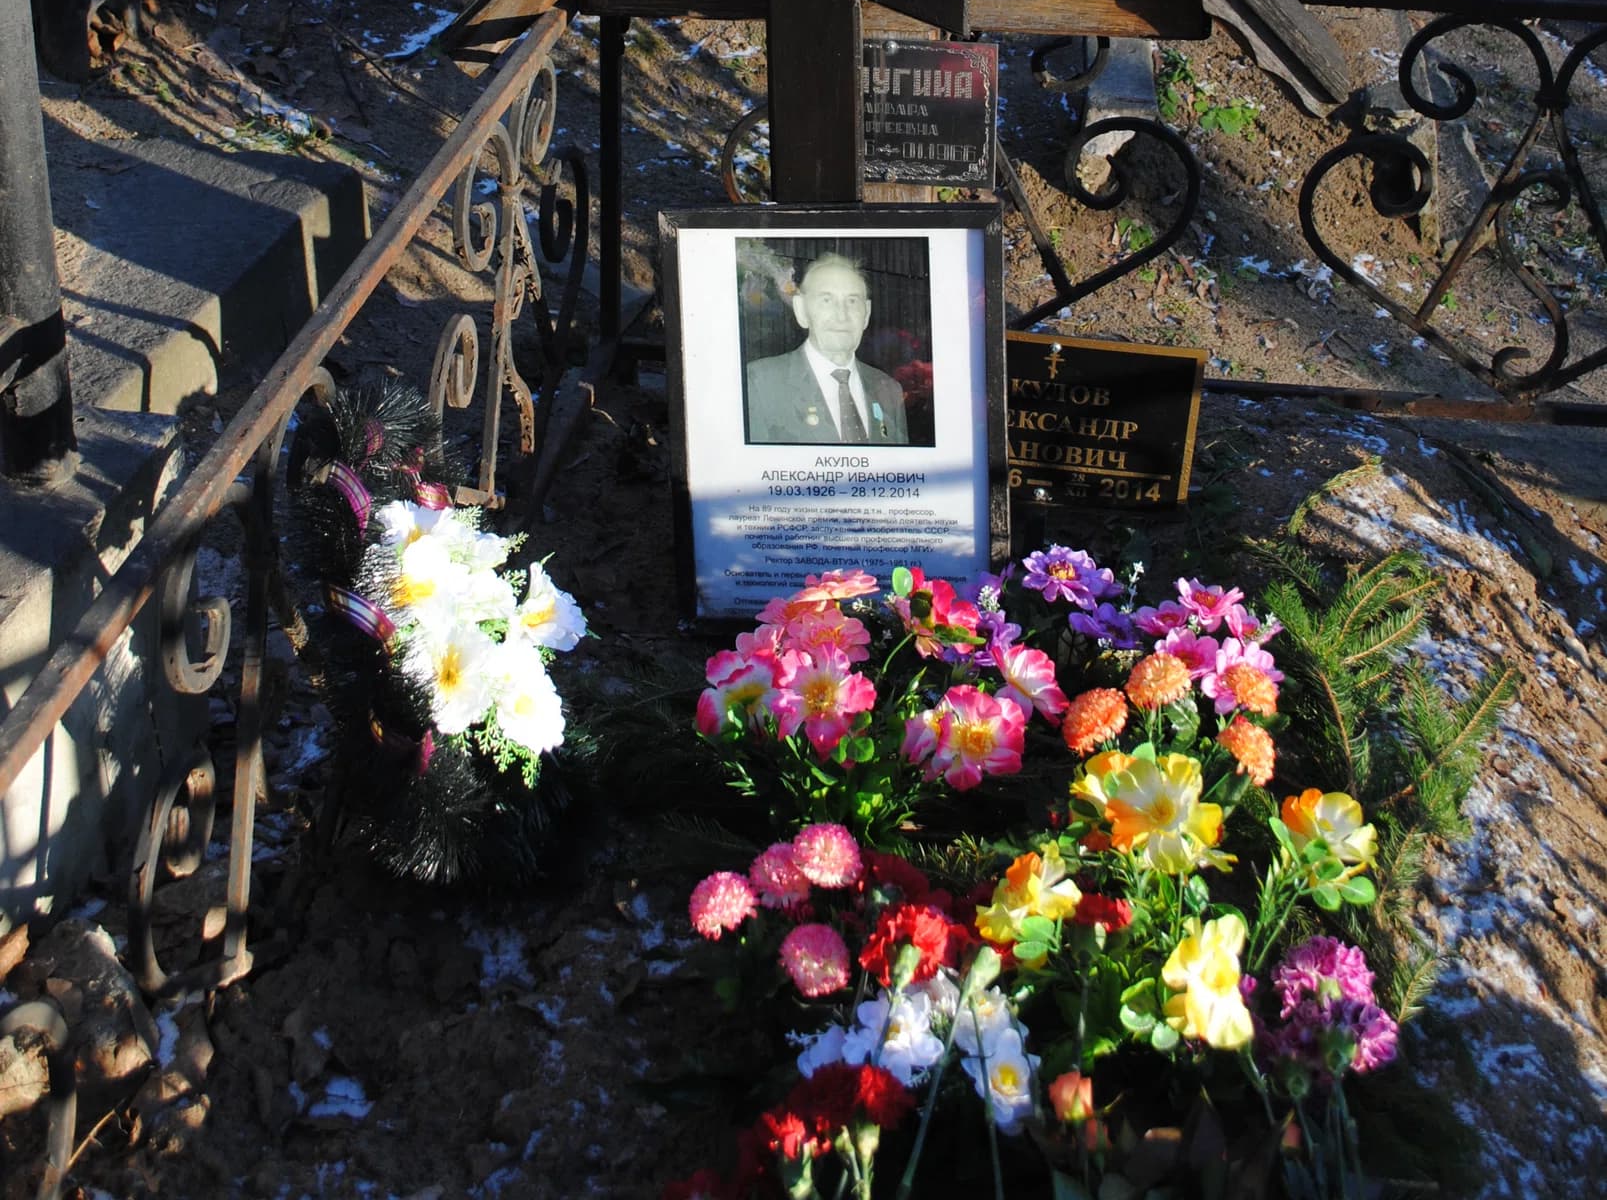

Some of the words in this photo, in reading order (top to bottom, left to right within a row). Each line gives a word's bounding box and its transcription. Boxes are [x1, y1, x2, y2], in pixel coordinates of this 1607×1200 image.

[865, 102, 929, 116] АРВАРА
[1010, 378, 1111, 407] КУЛОВ
[1007, 408, 1139, 441] ЕКСАНДР
[815, 456, 870, 468] АКУЛОВ
[1007, 440, 1128, 470] АНОВИЧ
[761, 470, 844, 484] АЛЕКСАНДР
[848, 472, 925, 484] ИВАНОВИЧ
[768, 485, 836, 497] 19.03.1926
[851, 486, 920, 498] 28.12.2014
[1101, 478, 1161, 502] 2014
[774, 506, 791, 514] году
